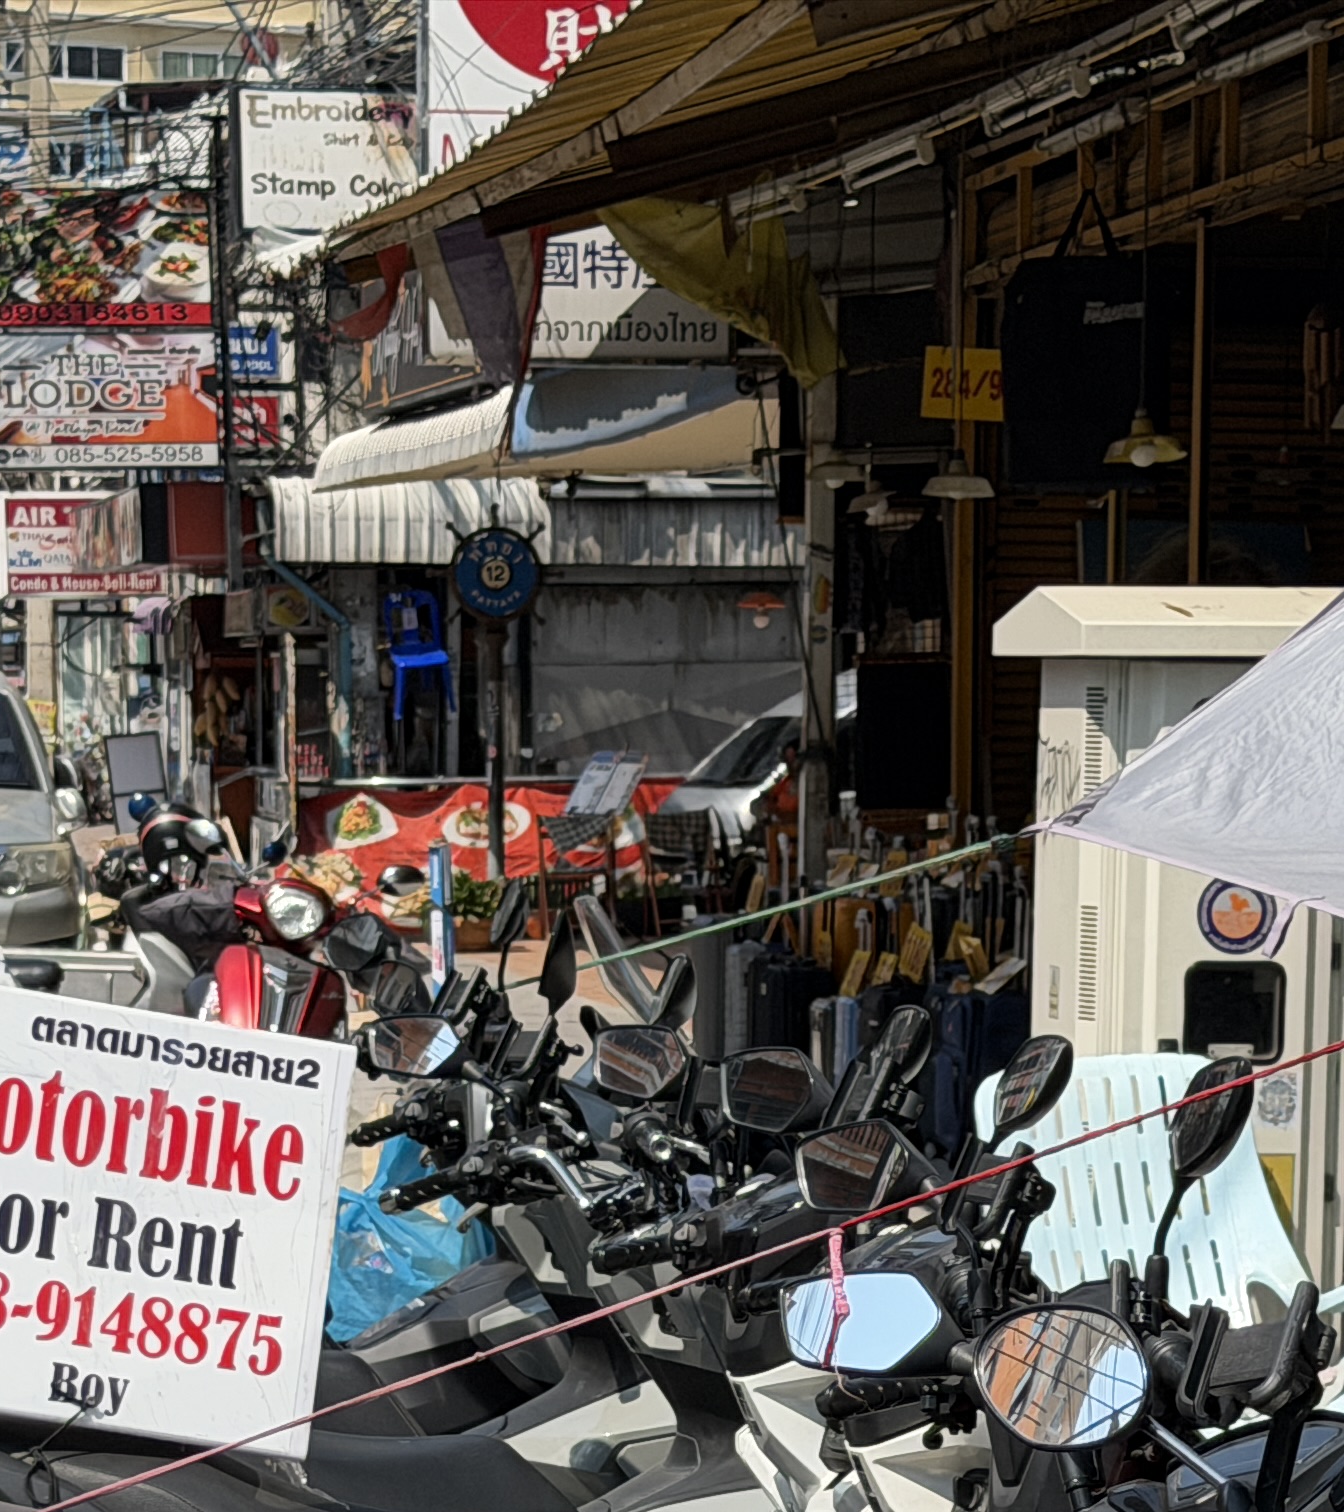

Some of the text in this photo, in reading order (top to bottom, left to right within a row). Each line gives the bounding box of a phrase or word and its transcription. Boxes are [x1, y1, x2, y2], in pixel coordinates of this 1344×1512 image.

[250, 172, 337, 200] Stamp
[51, 353, 120, 376] THE
[2, 378, 164, 409] LODGE
[55, 448, 204, 464] 085-525-5958
[12, 506, 57, 527] AIR
[10, 575, 48, 591] Condo
[485, 565, 506, 582] 12
[86, 1195, 245, 1291] Rent
[47, 1361, 131, 1418] Boy
